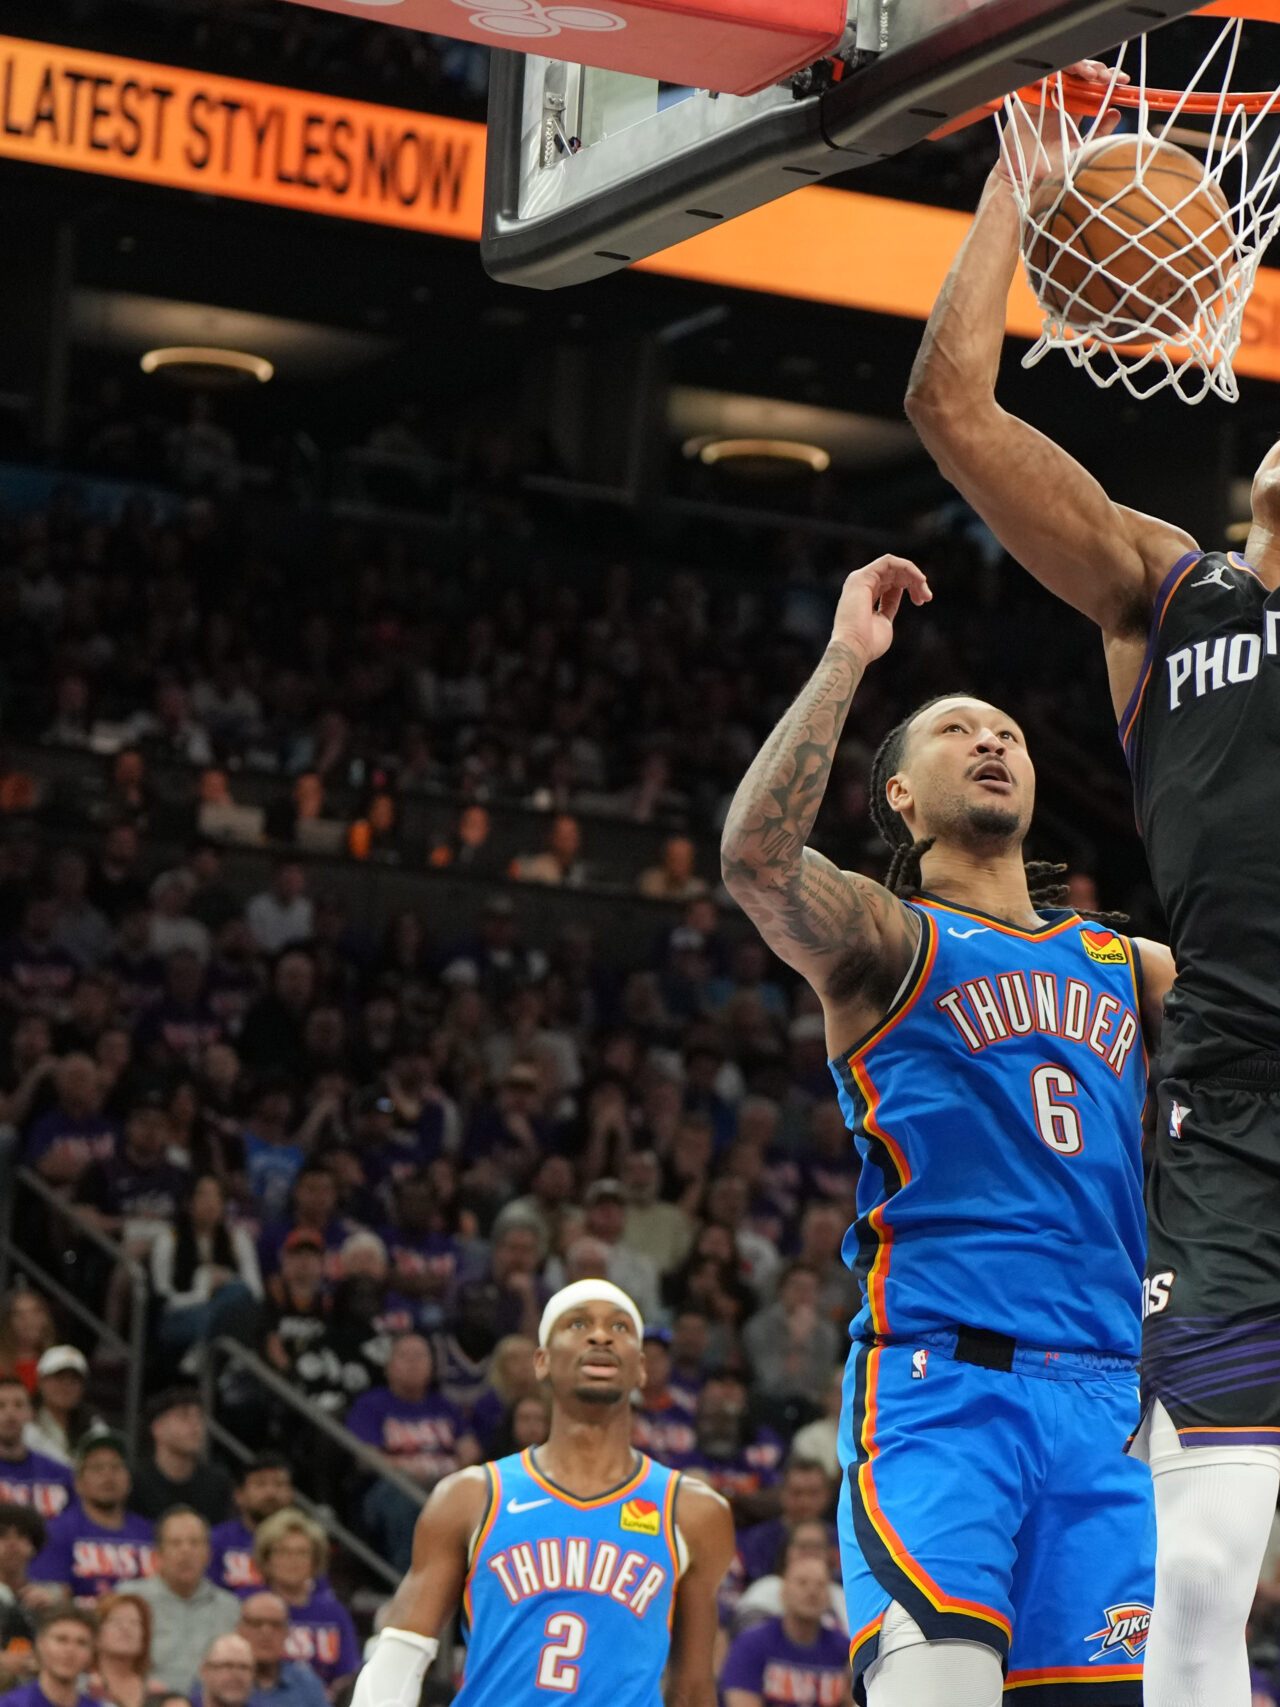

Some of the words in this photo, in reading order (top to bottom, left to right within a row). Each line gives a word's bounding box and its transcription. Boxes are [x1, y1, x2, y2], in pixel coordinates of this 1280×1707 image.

[4, 56, 173, 161] LATEST
[184, 92, 352, 194] STYLES
[362, 127, 470, 214] NOW
[935, 971, 1137, 1079] THUNDER
[1030, 1063, 1083, 1155] 6
[487, 1537, 666, 1620] THUNDER
[535, 1611, 588, 1693] 2
[1106, 1614, 1150, 1647] OKC
